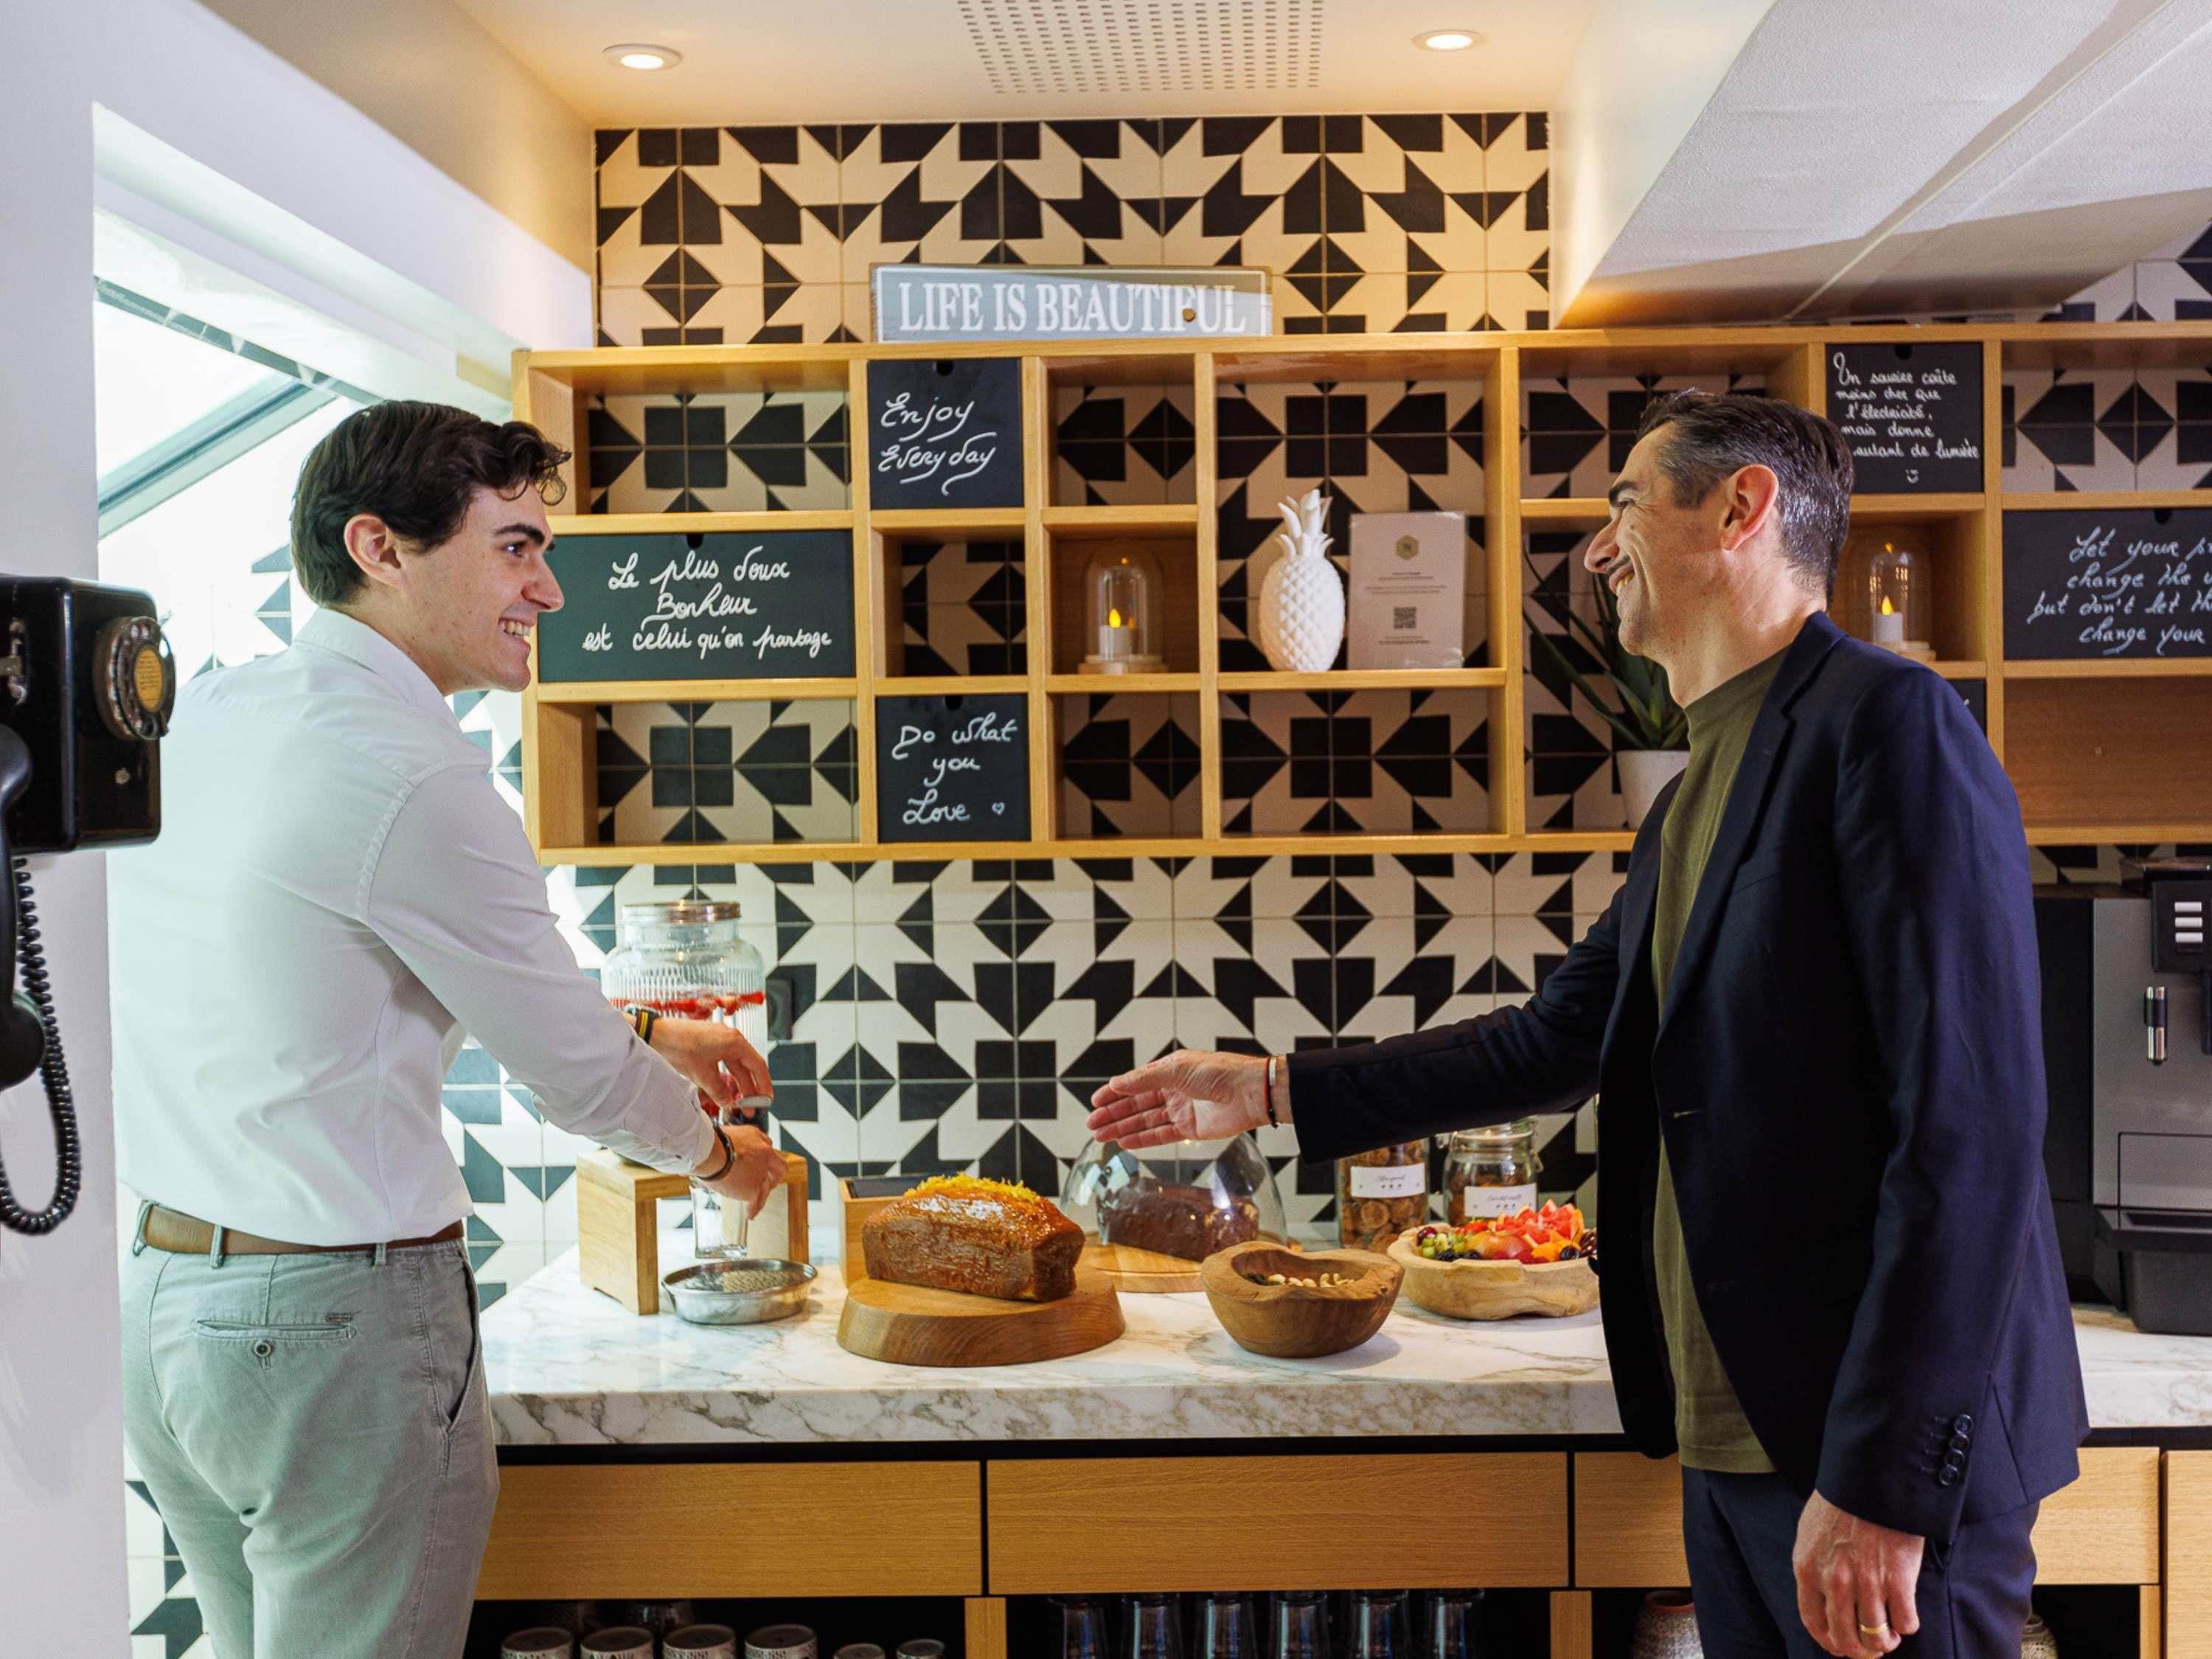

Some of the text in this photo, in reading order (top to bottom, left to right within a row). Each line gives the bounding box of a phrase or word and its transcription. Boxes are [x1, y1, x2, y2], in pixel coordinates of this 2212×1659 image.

[898, 282, 1247, 333] LIFE IS BEAUTIFUL
[880, 392, 975, 442] Enjoy
[1840, 420, 1935, 438] mais donne
[1852, 440, 1905, 458] autant
[1910, 442, 1930, 458] de
[608, 546, 790, 594] Le plus doux
[2068, 526, 2116, 563] Let
[2104, 539, 2180, 577] your
[2066, 560, 2145, 601] change
[2157, 560, 2192, 587] the
[641, 582, 758, 631] Bonheur
[2026, 590, 2070, 625] but
[2079, 593, 2136, 616] don't
[582, 622, 832, 661] est celui qu'on partage
[2079, 614, 2207, 656] change your
[891, 725, 936, 761] Do
[923, 757, 981, 788] you
[902, 787, 970, 826] Love
